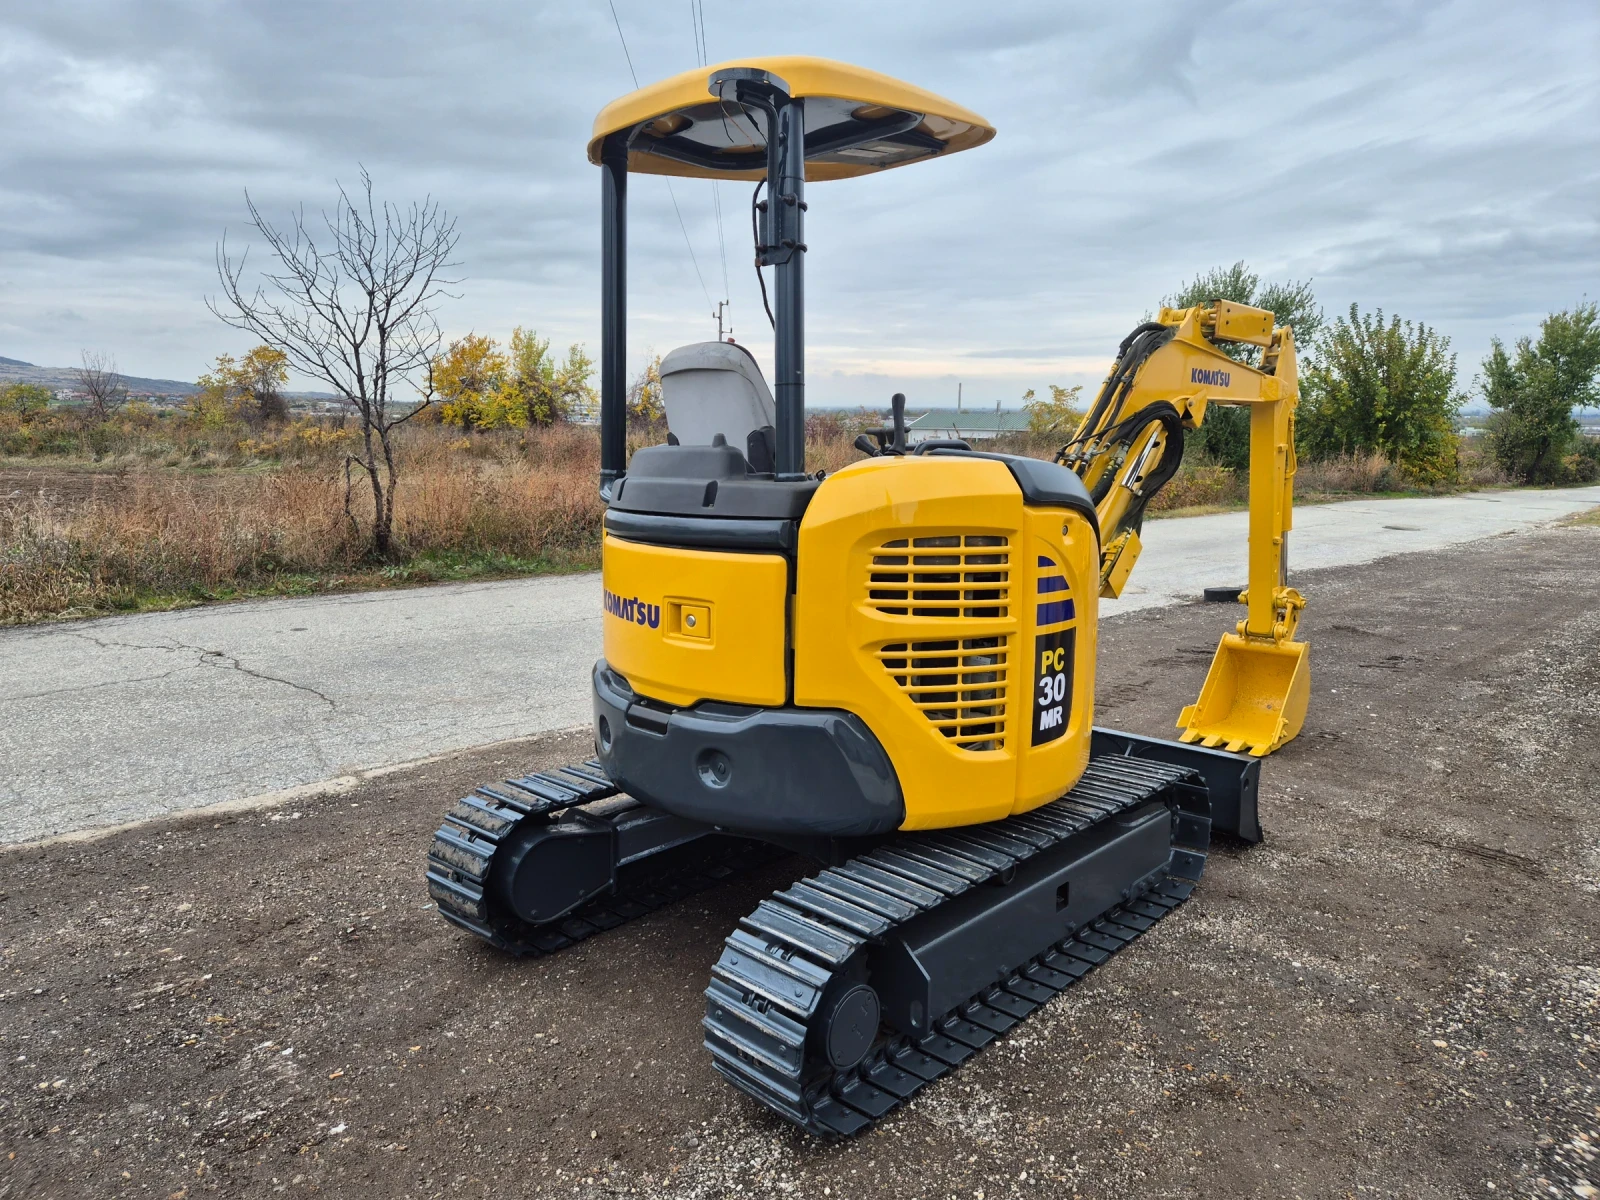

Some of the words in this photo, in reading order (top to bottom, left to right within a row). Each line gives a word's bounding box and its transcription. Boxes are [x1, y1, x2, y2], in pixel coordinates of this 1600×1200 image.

[1191, 368, 1230, 387] KOMATSU
[604, 589, 660, 629] KOMATSU
[1041, 648, 1064, 675] PC
[1038, 673, 1065, 706] 30
[1039, 706, 1063, 731] MR
